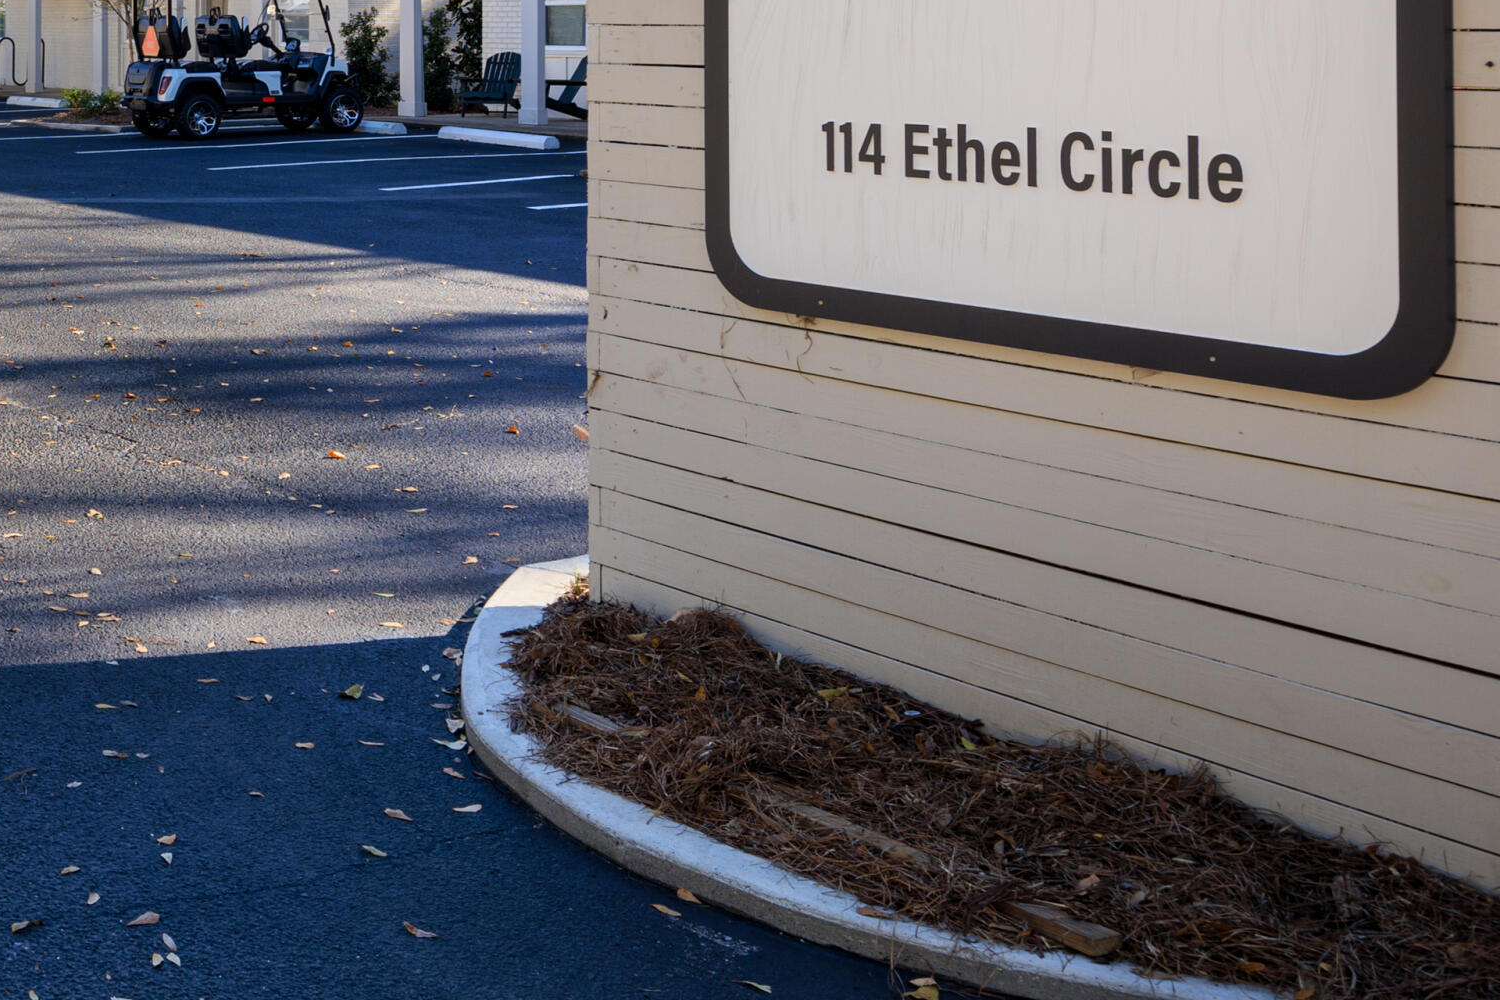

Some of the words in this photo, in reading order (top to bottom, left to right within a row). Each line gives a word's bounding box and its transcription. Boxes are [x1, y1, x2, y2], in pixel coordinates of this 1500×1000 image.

[821, 121, 886, 176] 114
[903, 123, 1038, 188] Ethel
[1060, 130, 1244, 204] Circle
